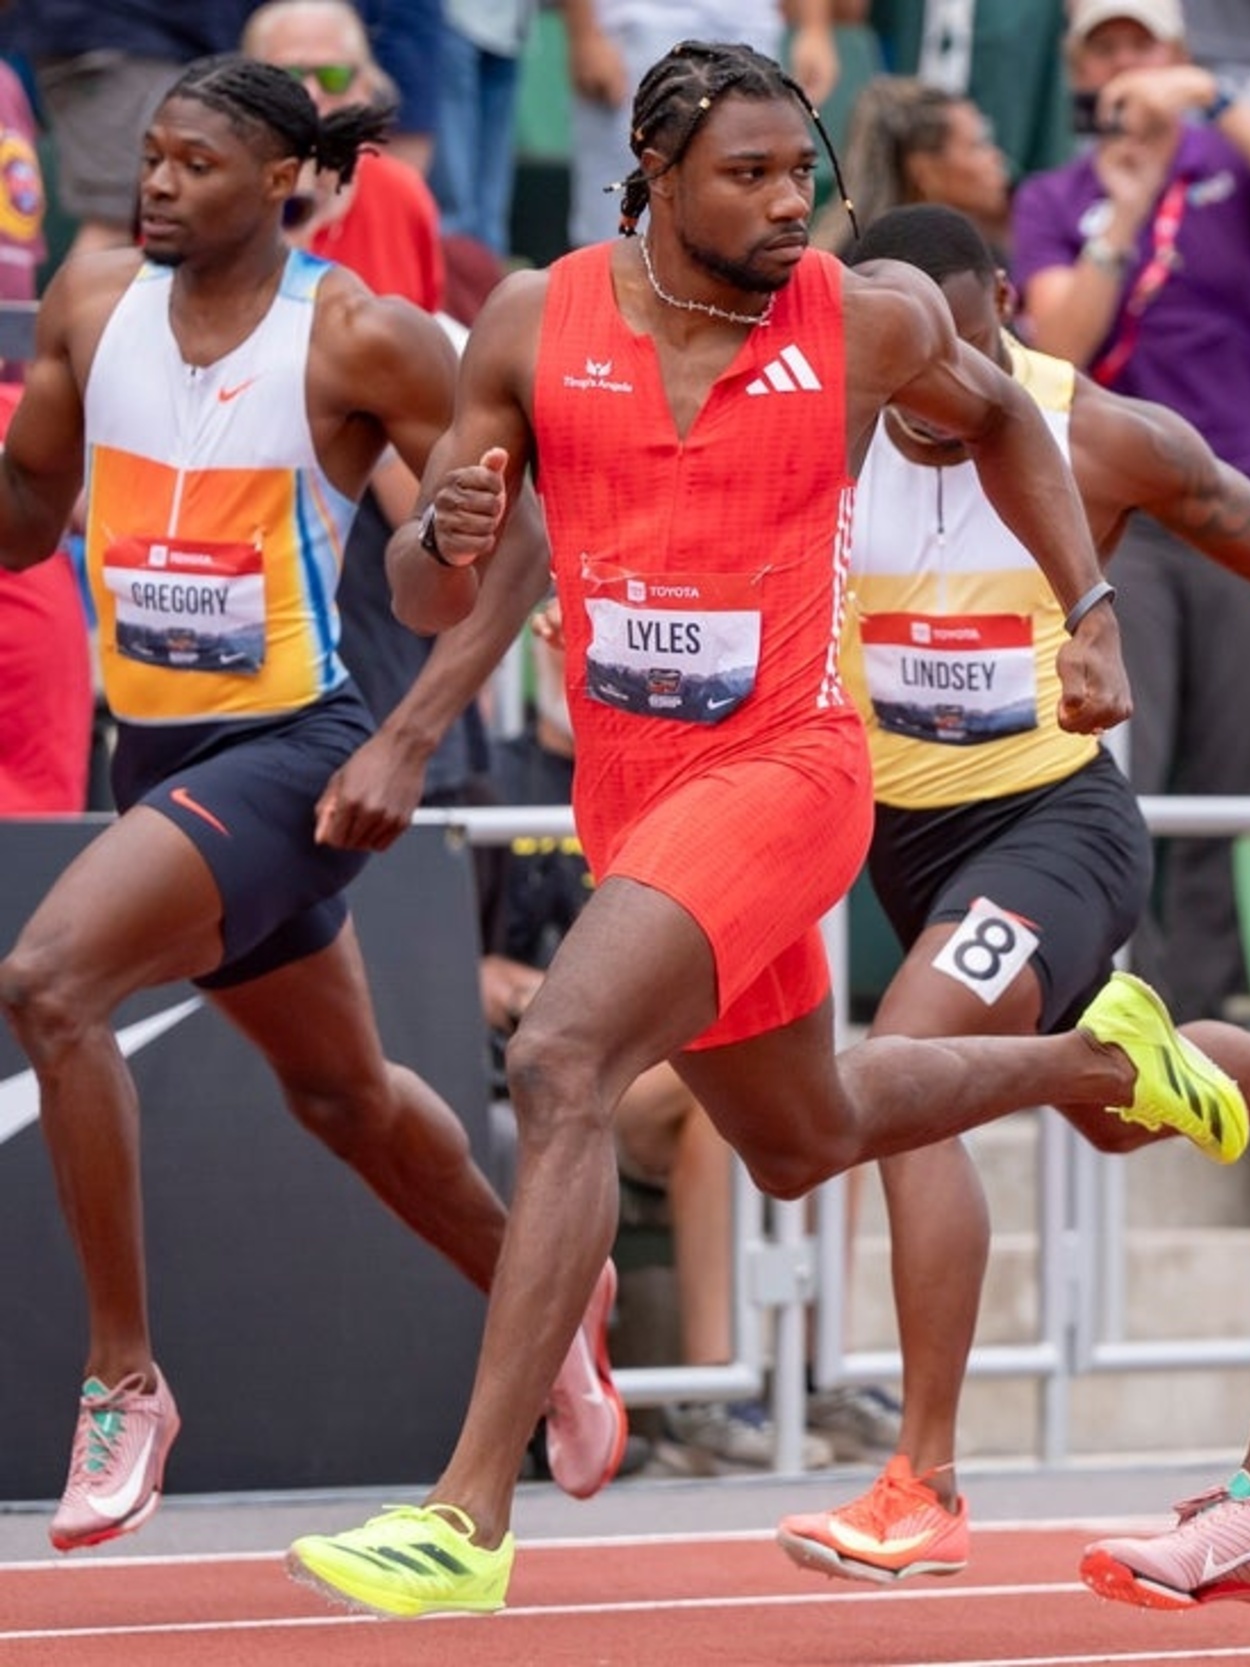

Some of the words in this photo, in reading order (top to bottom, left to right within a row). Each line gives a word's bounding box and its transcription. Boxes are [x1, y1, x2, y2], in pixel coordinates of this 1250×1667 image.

[131, 582, 229, 615] GREGORY
[649, 586, 699, 598] TOYOTA
[627, 618, 702, 655] LYLES
[901, 656, 996, 691] LINDSEY
[953, 917, 1016, 981] 8
